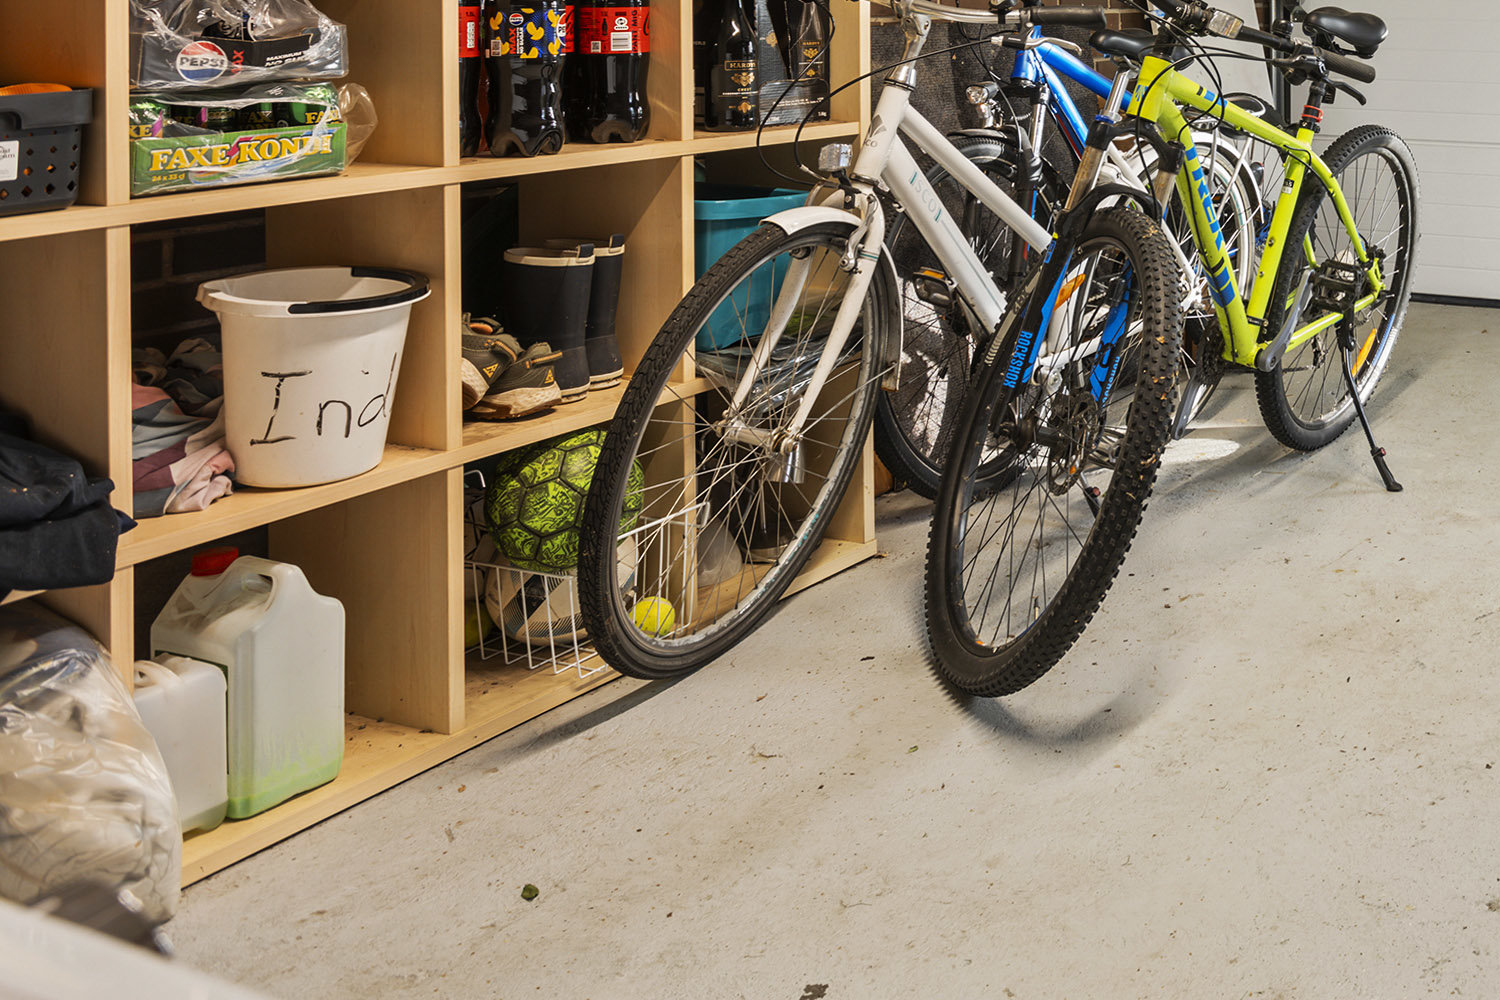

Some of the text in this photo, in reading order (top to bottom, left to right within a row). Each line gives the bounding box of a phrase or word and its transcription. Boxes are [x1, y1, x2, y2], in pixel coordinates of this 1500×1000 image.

[509, 27, 517, 55] MAX
[180, 56, 226, 68] PEPSI
[150, 134, 332, 171] FAXE KONDI
[1003, 330, 1033, 389] ROCKSHOX
